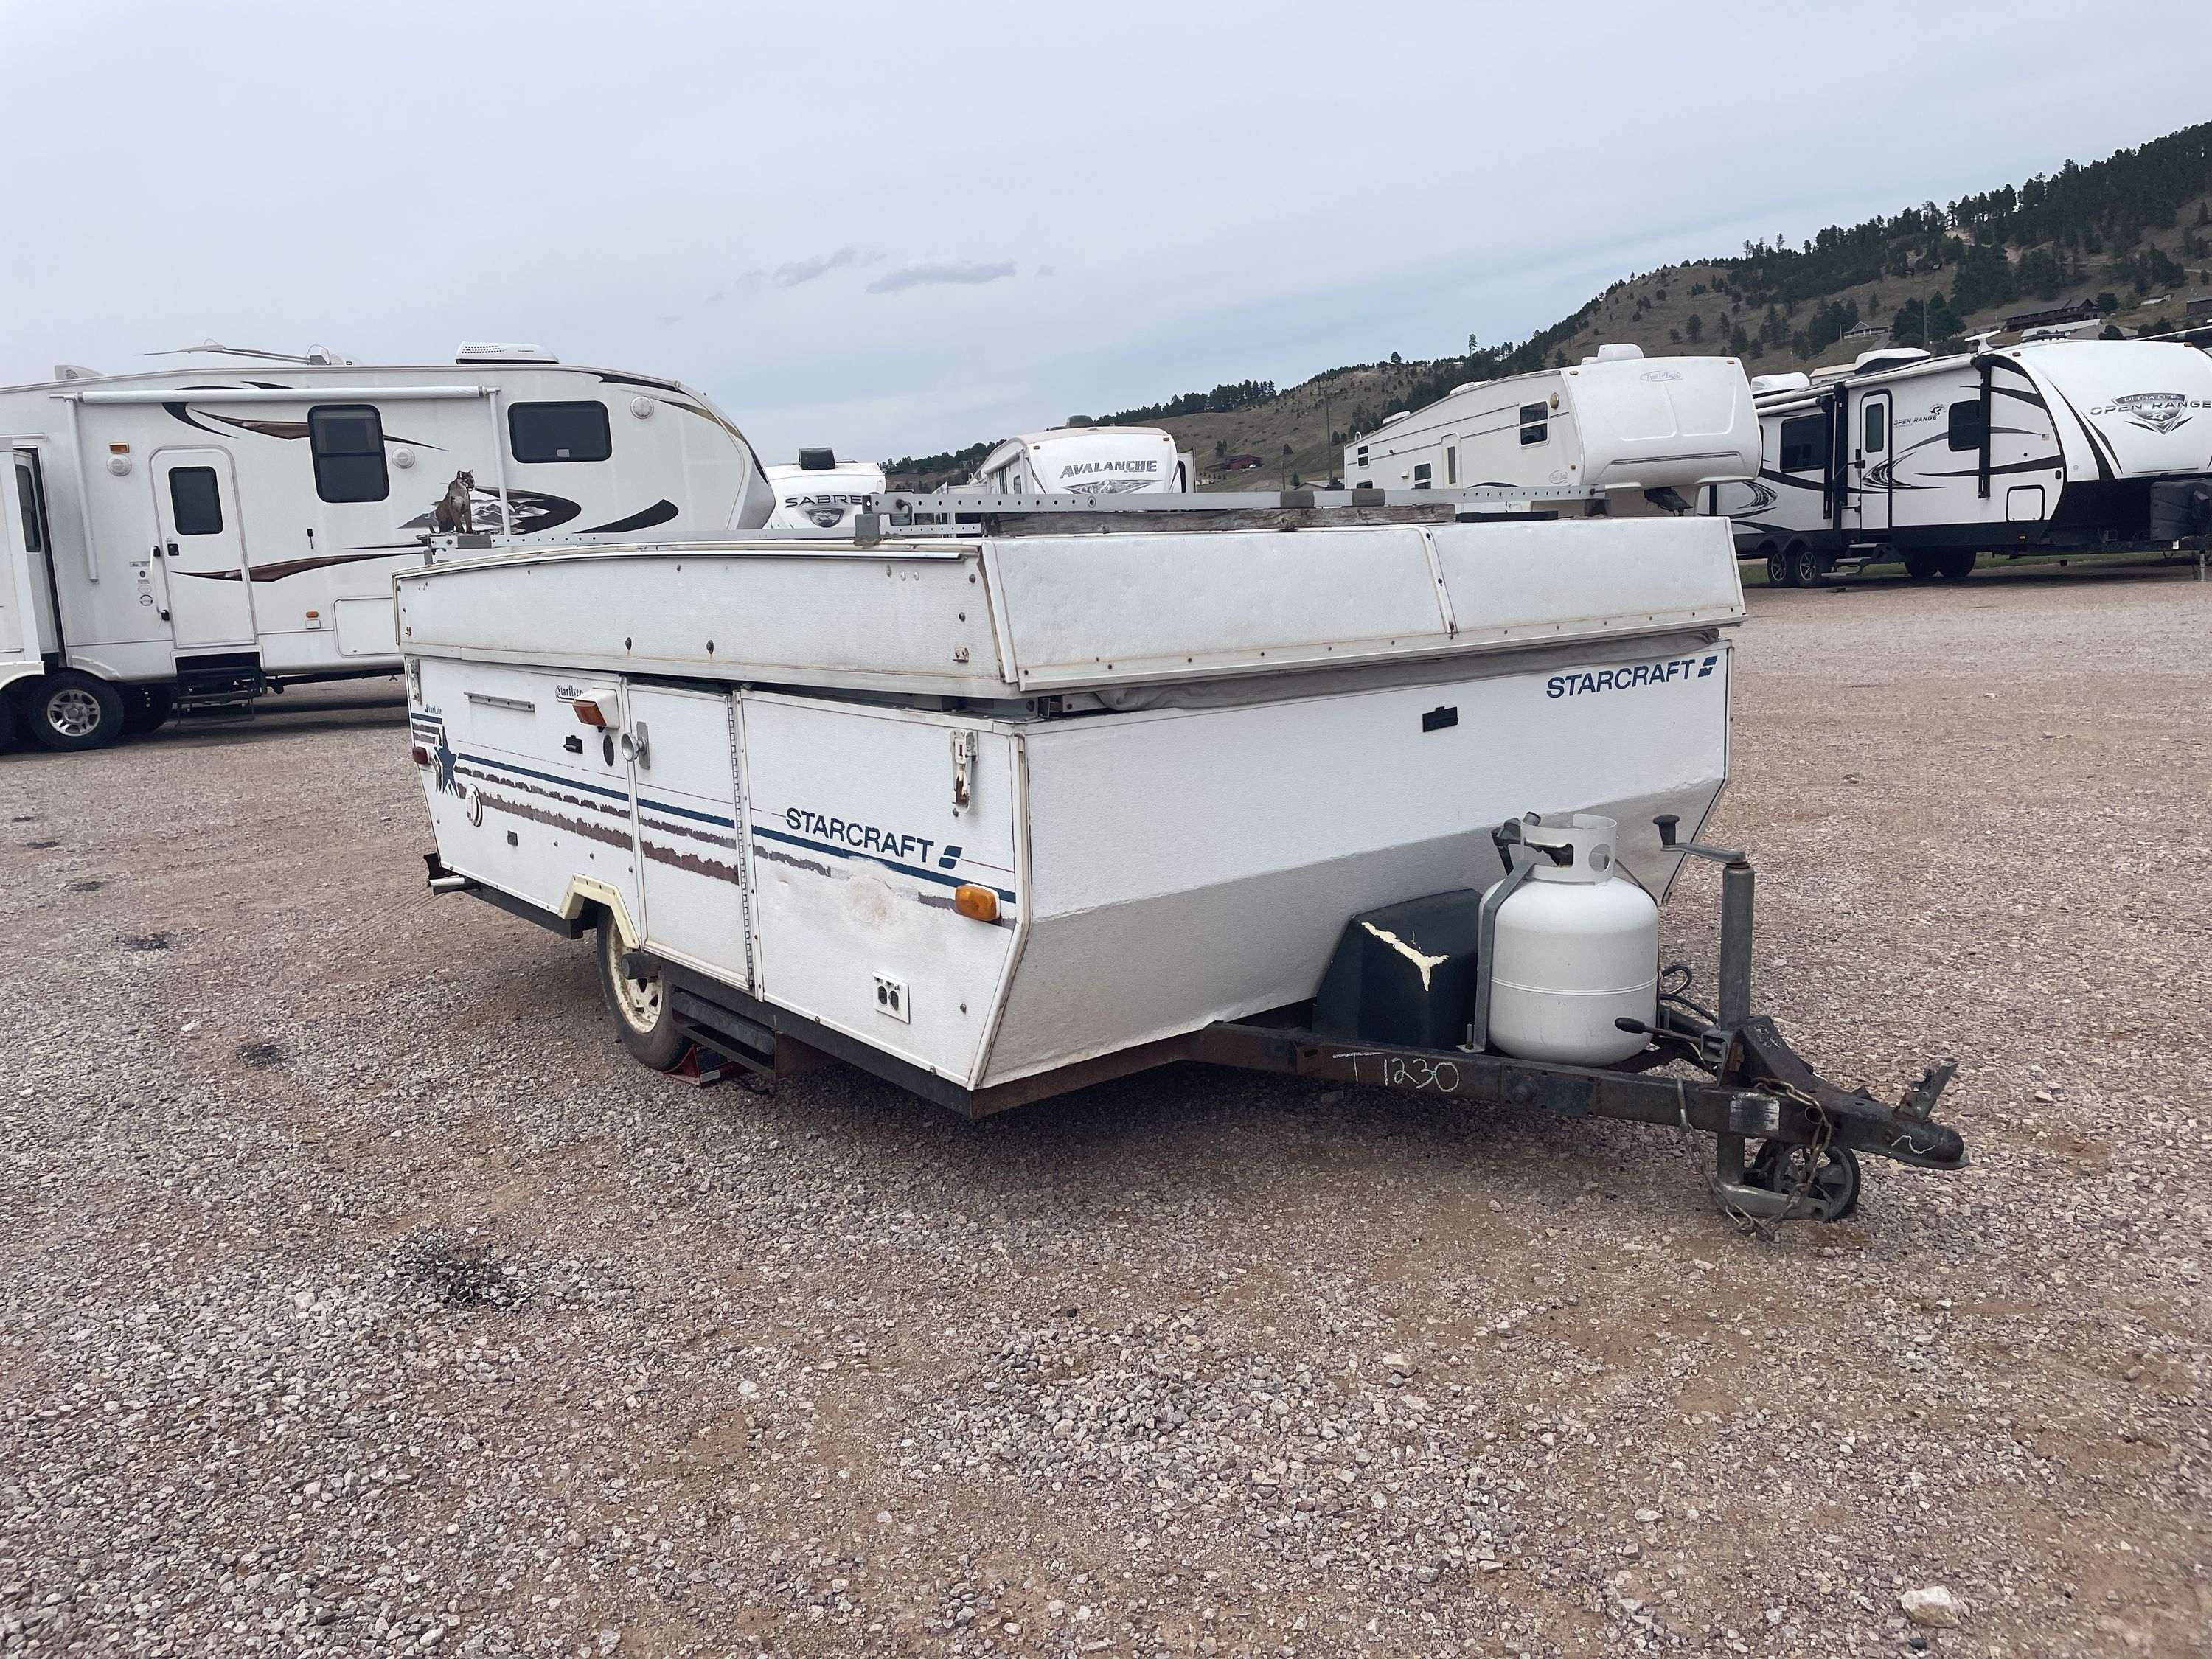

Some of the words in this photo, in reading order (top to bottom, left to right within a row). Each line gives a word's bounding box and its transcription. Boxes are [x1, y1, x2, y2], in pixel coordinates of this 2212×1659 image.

[2090, 403, 2143, 416] OPEN
[2152, 400, 2212, 410] RANGE
[1913, 414, 1937, 423] RANGE
[1060, 459, 1158, 479] AVALANCHE
[784, 495, 863, 509] SABRE
[1545, 658, 1696, 699] STARCRAFT
[785, 807, 935, 863] STARCRAFT
